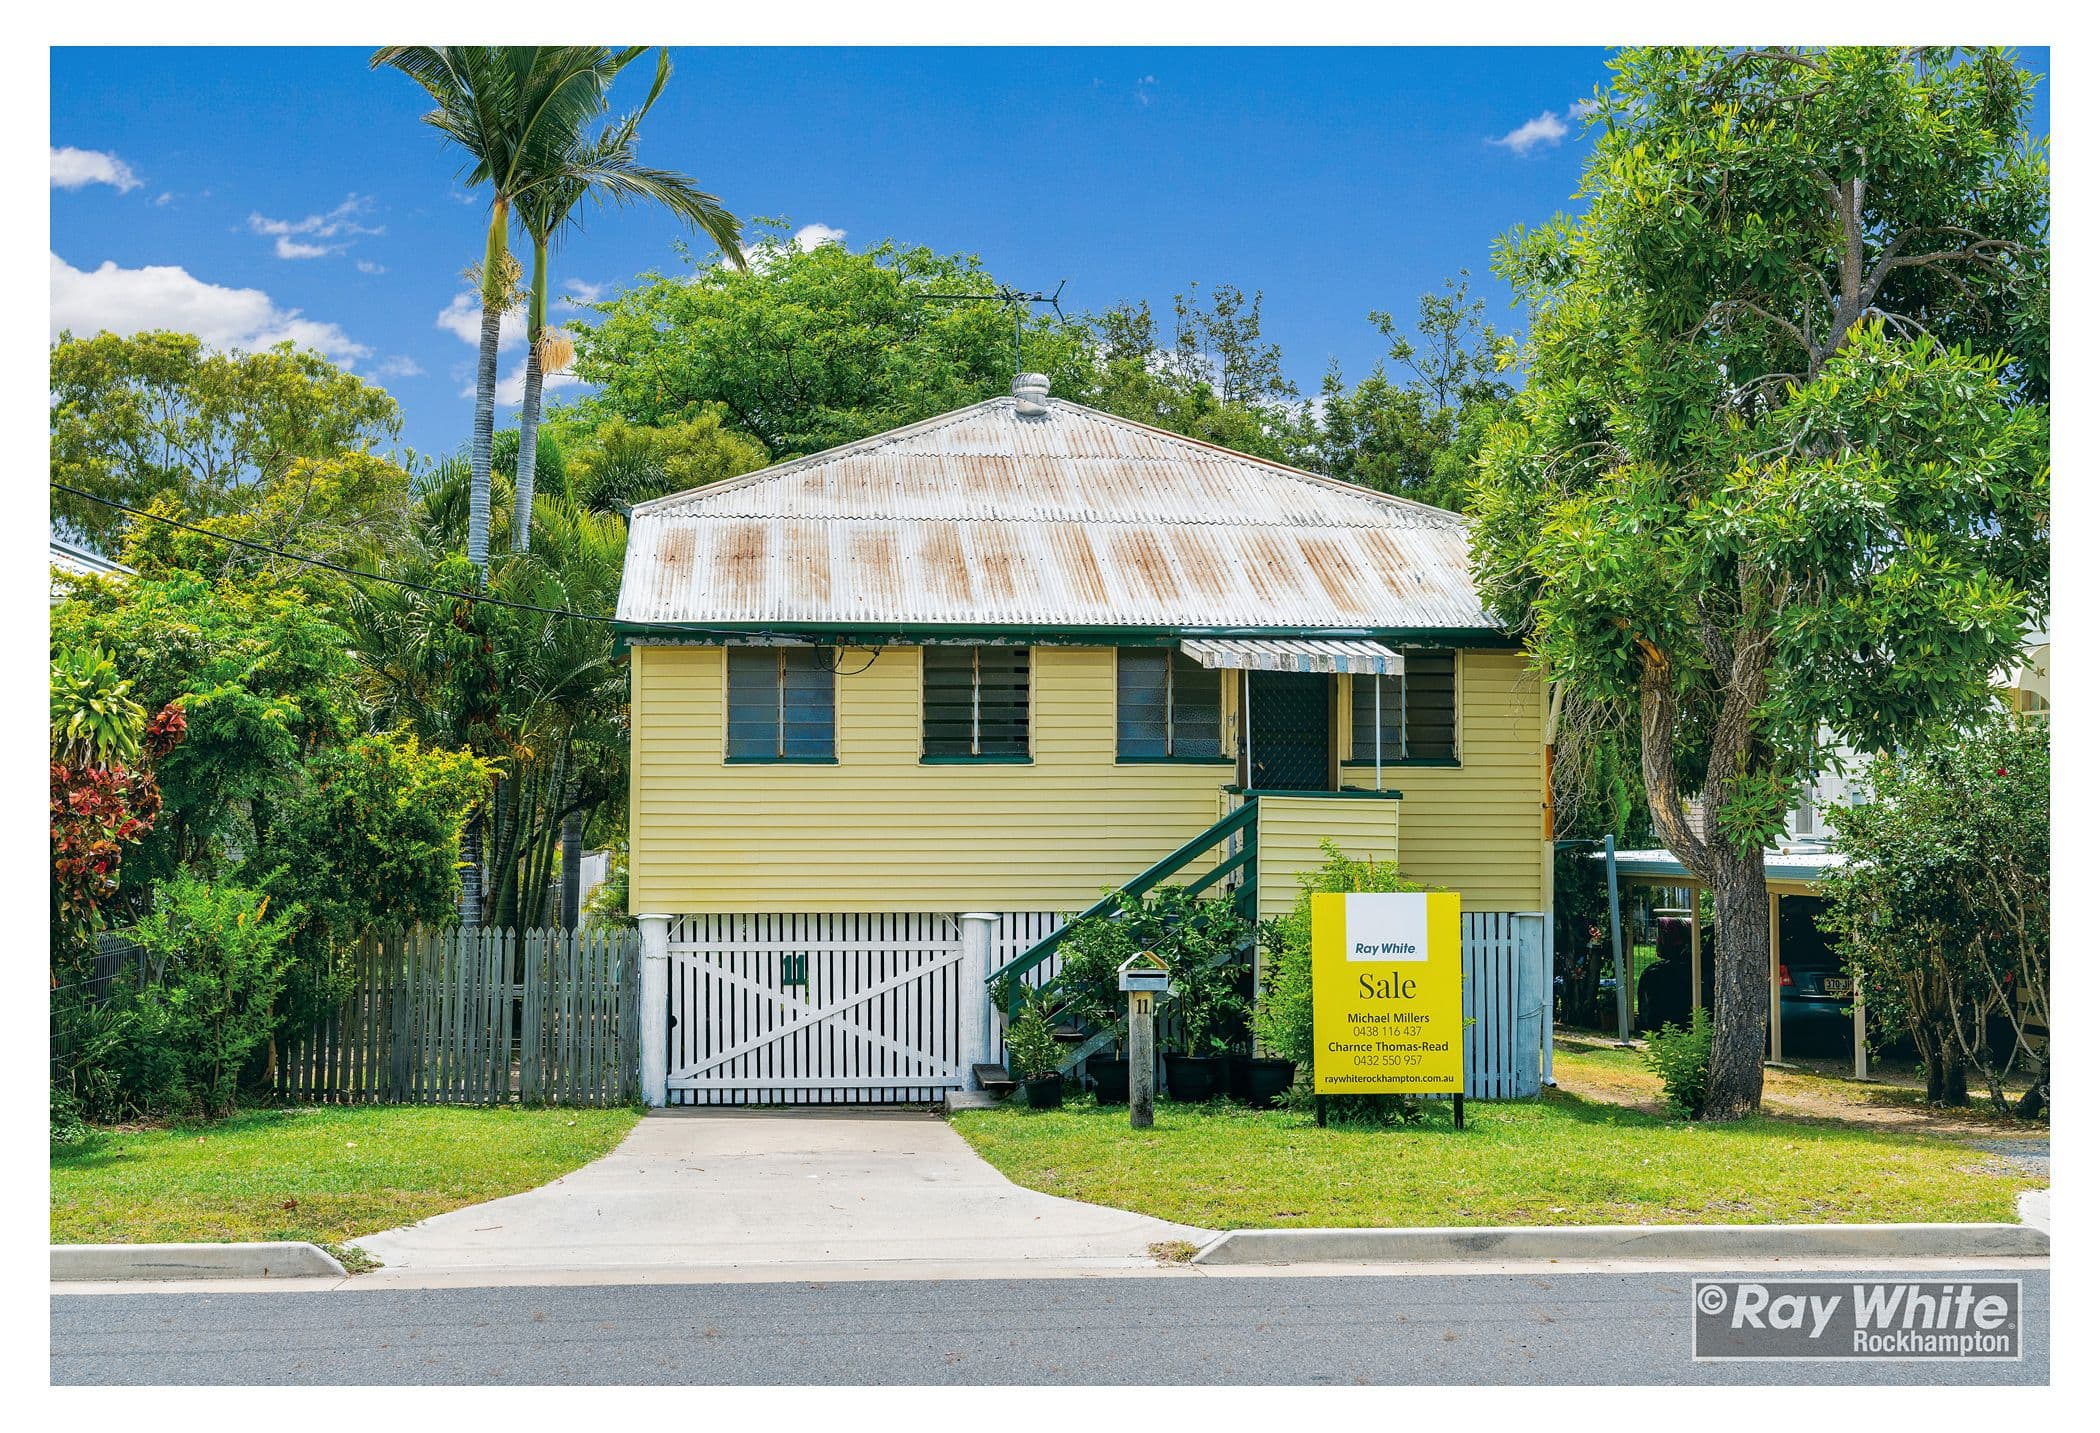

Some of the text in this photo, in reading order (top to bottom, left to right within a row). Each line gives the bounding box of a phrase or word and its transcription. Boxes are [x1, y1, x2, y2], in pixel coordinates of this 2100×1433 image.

[1355, 943, 1416, 956] Ray White
[783, 954, 806, 986] 11
[1359, 971, 1417, 1000] Sale
[1136, 998, 1149, 1015] 11
[1347, 1013, 1430, 1023] Michael Millers
[1353, 1026, 1422, 1037] 0438 116 437
[1328, 1041, 1449, 1052] Charnce Thomas-Read
[1353, 1055, 1423, 1066] 0432 550 957
[1324, 1074, 1454, 1084] raywhiterockhampton.com.au
